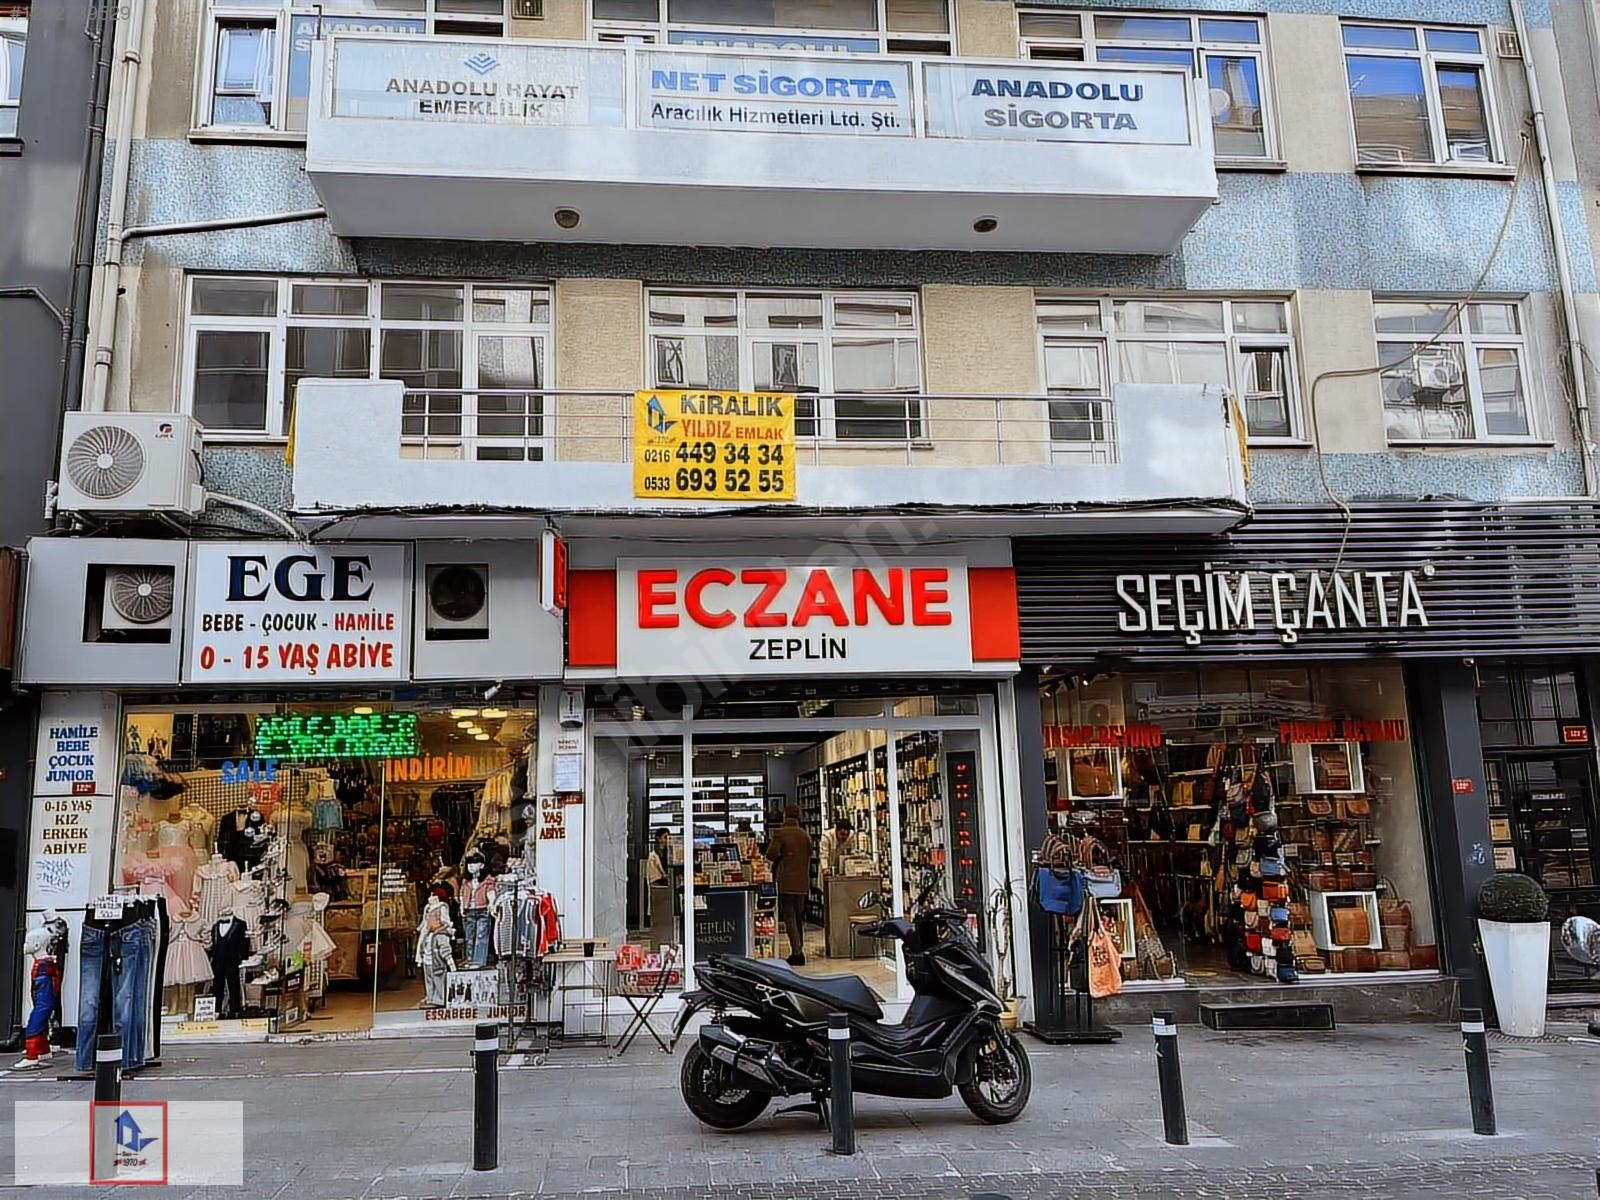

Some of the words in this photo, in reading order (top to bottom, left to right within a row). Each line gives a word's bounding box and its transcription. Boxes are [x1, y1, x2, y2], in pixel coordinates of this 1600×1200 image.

[385, 77, 497, 97] ANADOLU
[506, 82, 579, 100] HAYAT
[651, 70, 726, 92] NET
[733, 69, 897, 99] SİGORTA
[971, 78, 1143, 102] ANADOLU
[651, 103, 723, 122] Aracılık
[729, 107, 823, 126] Hizmetleri
[829, 111, 865, 127] Ltd.
[871, 111, 901, 132] Şti.
[984, 103, 1138, 130] SİGORTA
[681, 418, 732, 438] YILDIZ
[735, 426, 784, 441] EMLAK
[644, 449, 670, 463] 0216
[676, 441, 716, 464] 449
[724, 442, 750, 465] 34
[758, 443, 784, 466] 34
[644, 476, 670, 490] 0533
[676, 467, 717, 491] 693
[725, 468, 750, 491] 52
[758, 469, 784, 492] 55
[225, 554, 374, 602] EGE
[636, 567, 953, 629] ECZANE
[1115, 561, 1255, 645] SEÇİM
[1271, 569, 1429, 643] ÇANTA
[202, 613, 244, 632] BEBE
[261, 612, 317, 637] ÇOCUK
[334, 607, 394, 631] HAMİLE
[243, 645, 269, 669] 15
[278, 642, 320, 675] YAŞ
[326, 636, 393, 669] ABİYE
[749, 632, 847, 660] ZEPLİN
[49, 723, 98, 739] HAMİLE
[56, 740, 89, 752] BEBE
[49, 755, 94, 770] ÇOCUK
[220, 759, 278, 784] SALE
[46, 769, 94, 782] JUNIOR
[45, 800, 67, 812] 0-15
[71, 799, 92, 814] YAŞ
[55, 813, 79, 826] KIZ
[542, 812, 562, 827] YAŞ
[43, 828, 88, 840] ERKEK
[539, 825, 565, 840] ABİYE
[43, 840, 87, 855] ABİYE
